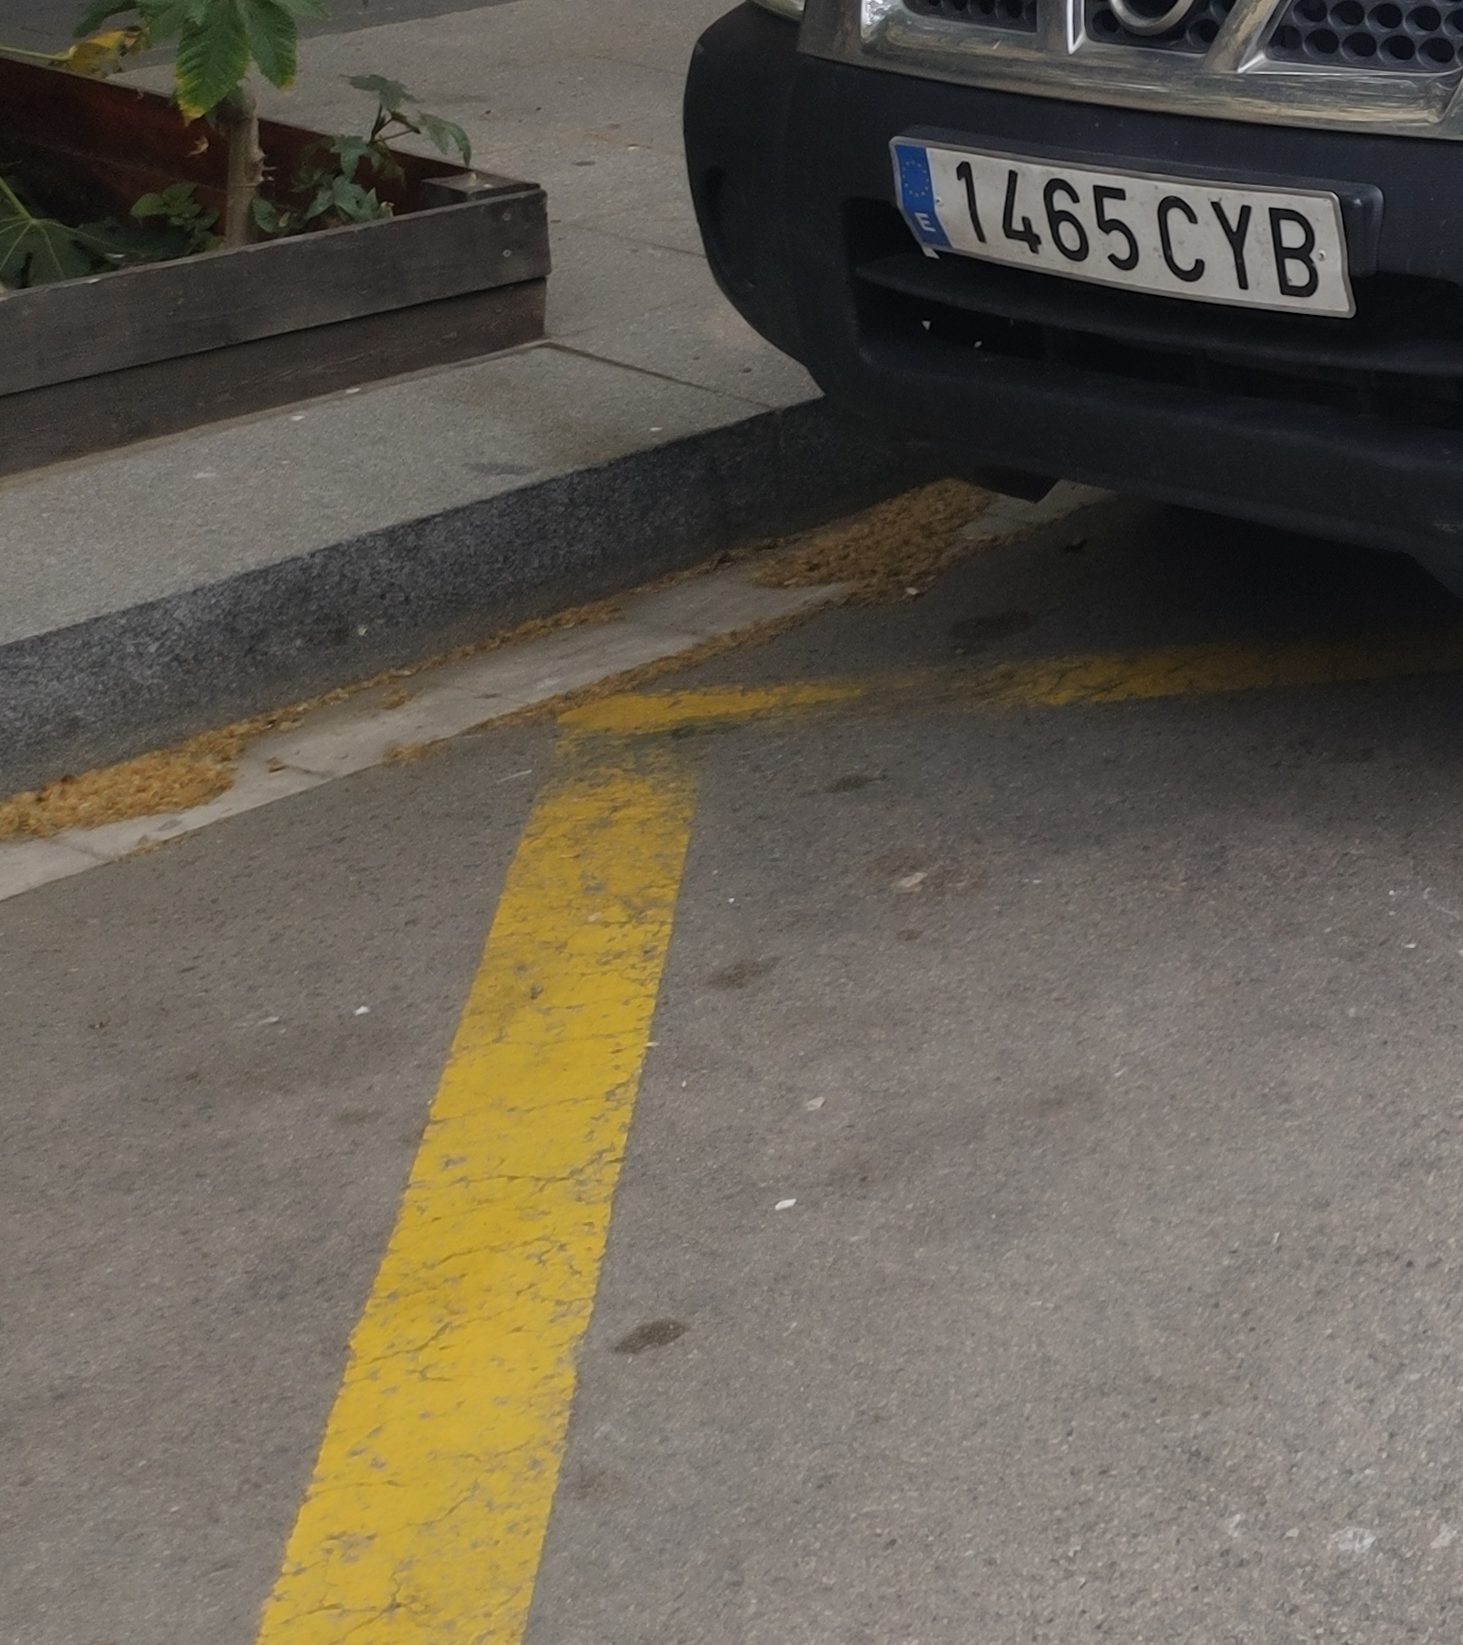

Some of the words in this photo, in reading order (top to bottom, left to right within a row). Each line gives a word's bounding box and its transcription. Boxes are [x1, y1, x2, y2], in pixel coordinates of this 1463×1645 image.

[914, 211, 937, 232] E
[956, 160, 1140, 272] 1465
[1157, 196, 1319, 298] CYB
